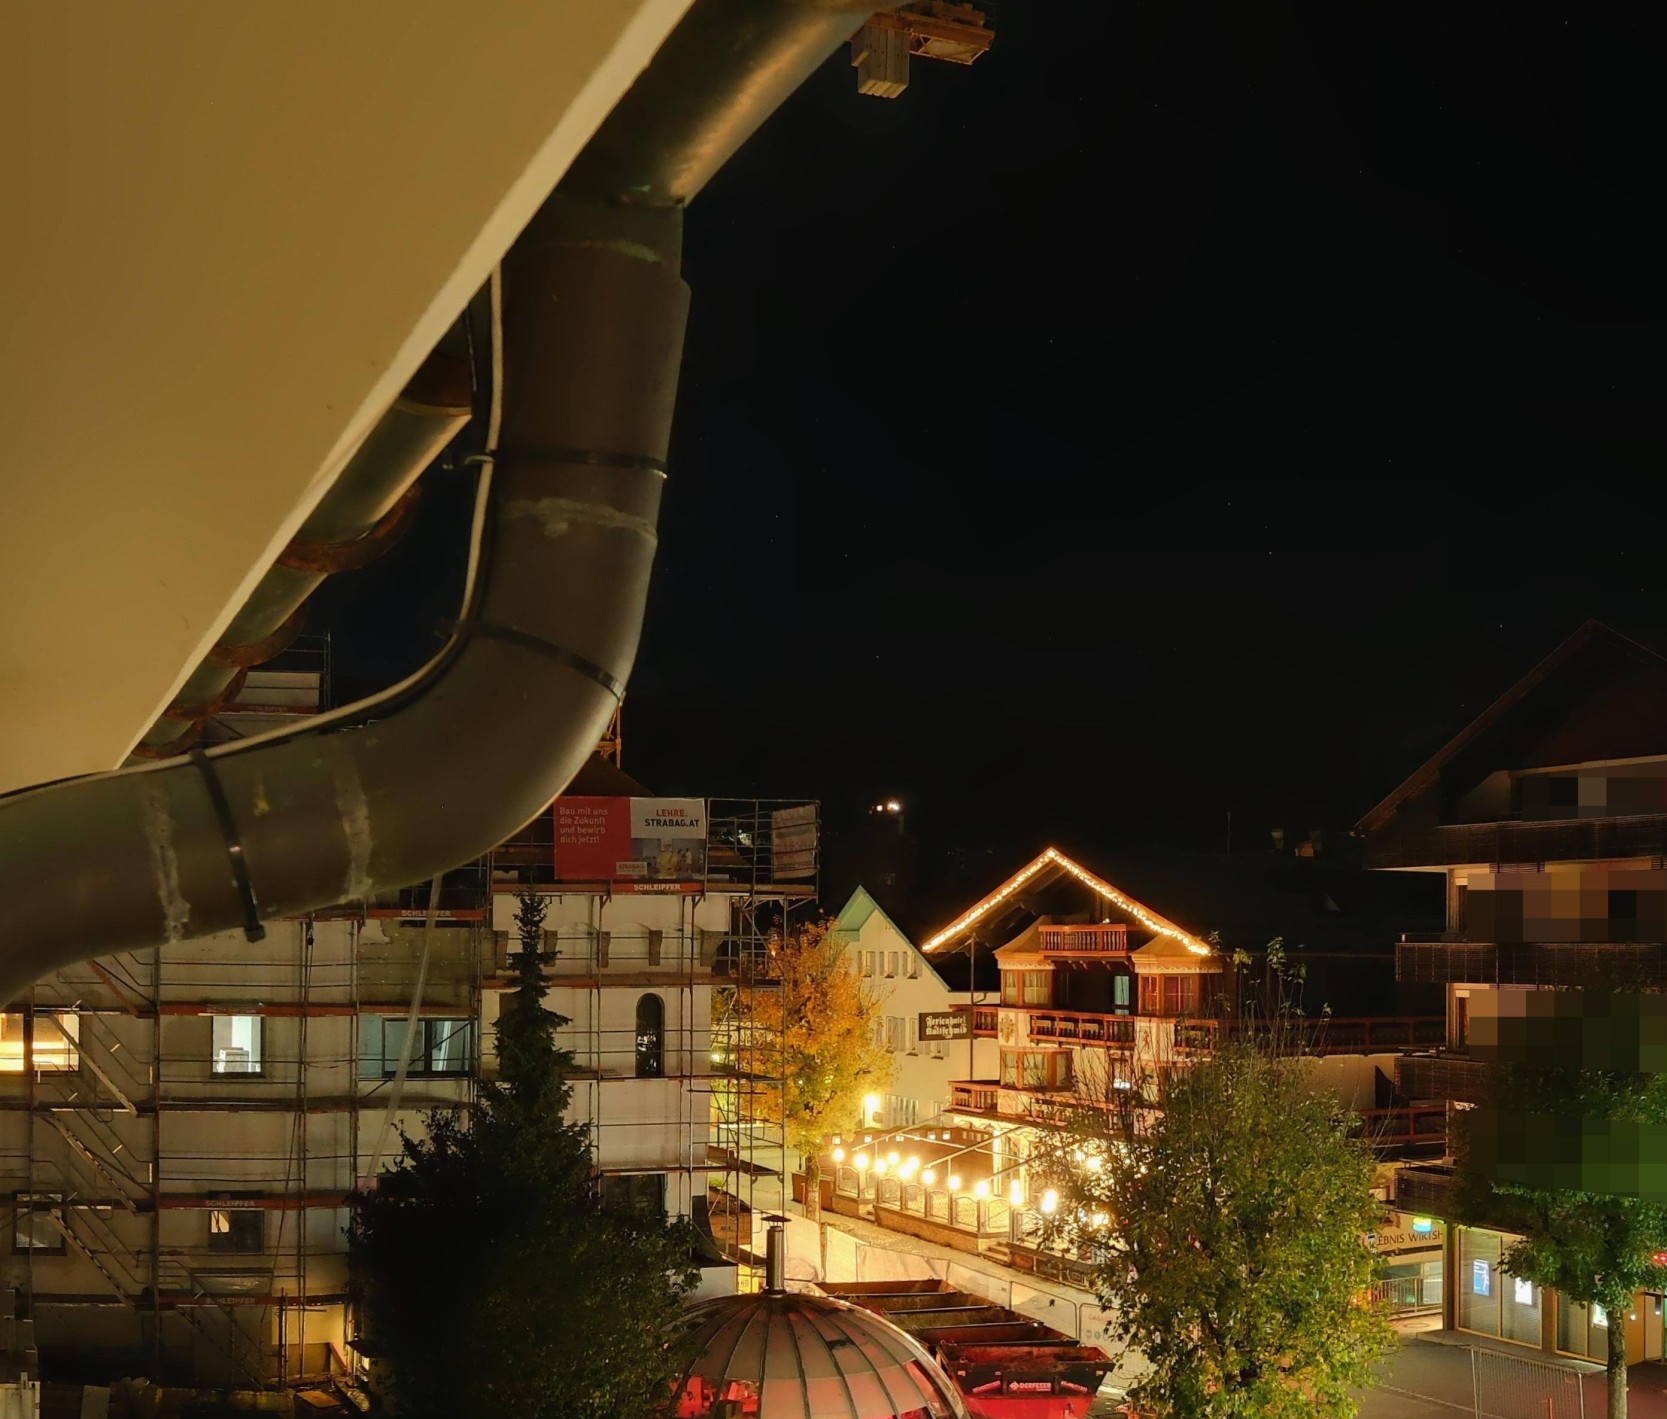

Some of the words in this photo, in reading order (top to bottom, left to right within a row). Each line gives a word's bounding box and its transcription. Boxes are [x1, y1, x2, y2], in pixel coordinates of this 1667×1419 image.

[560, 807, 575, 815] Bau
[577, 807, 591, 815] mit
[656, 809, 687, 817] LEHRE.
[560, 816, 572, 824] die
[574, 816, 606, 824] Zukunft
[644, 818, 699, 828] STRABAG.AT
[560, 826, 575, 834] und
[577, 826, 606, 834] bewirb
[560, 835, 576, 843] dich
[578, 835, 600, 845] jetzt!
[633, 883, 681, 891] SCHLEIPFER
